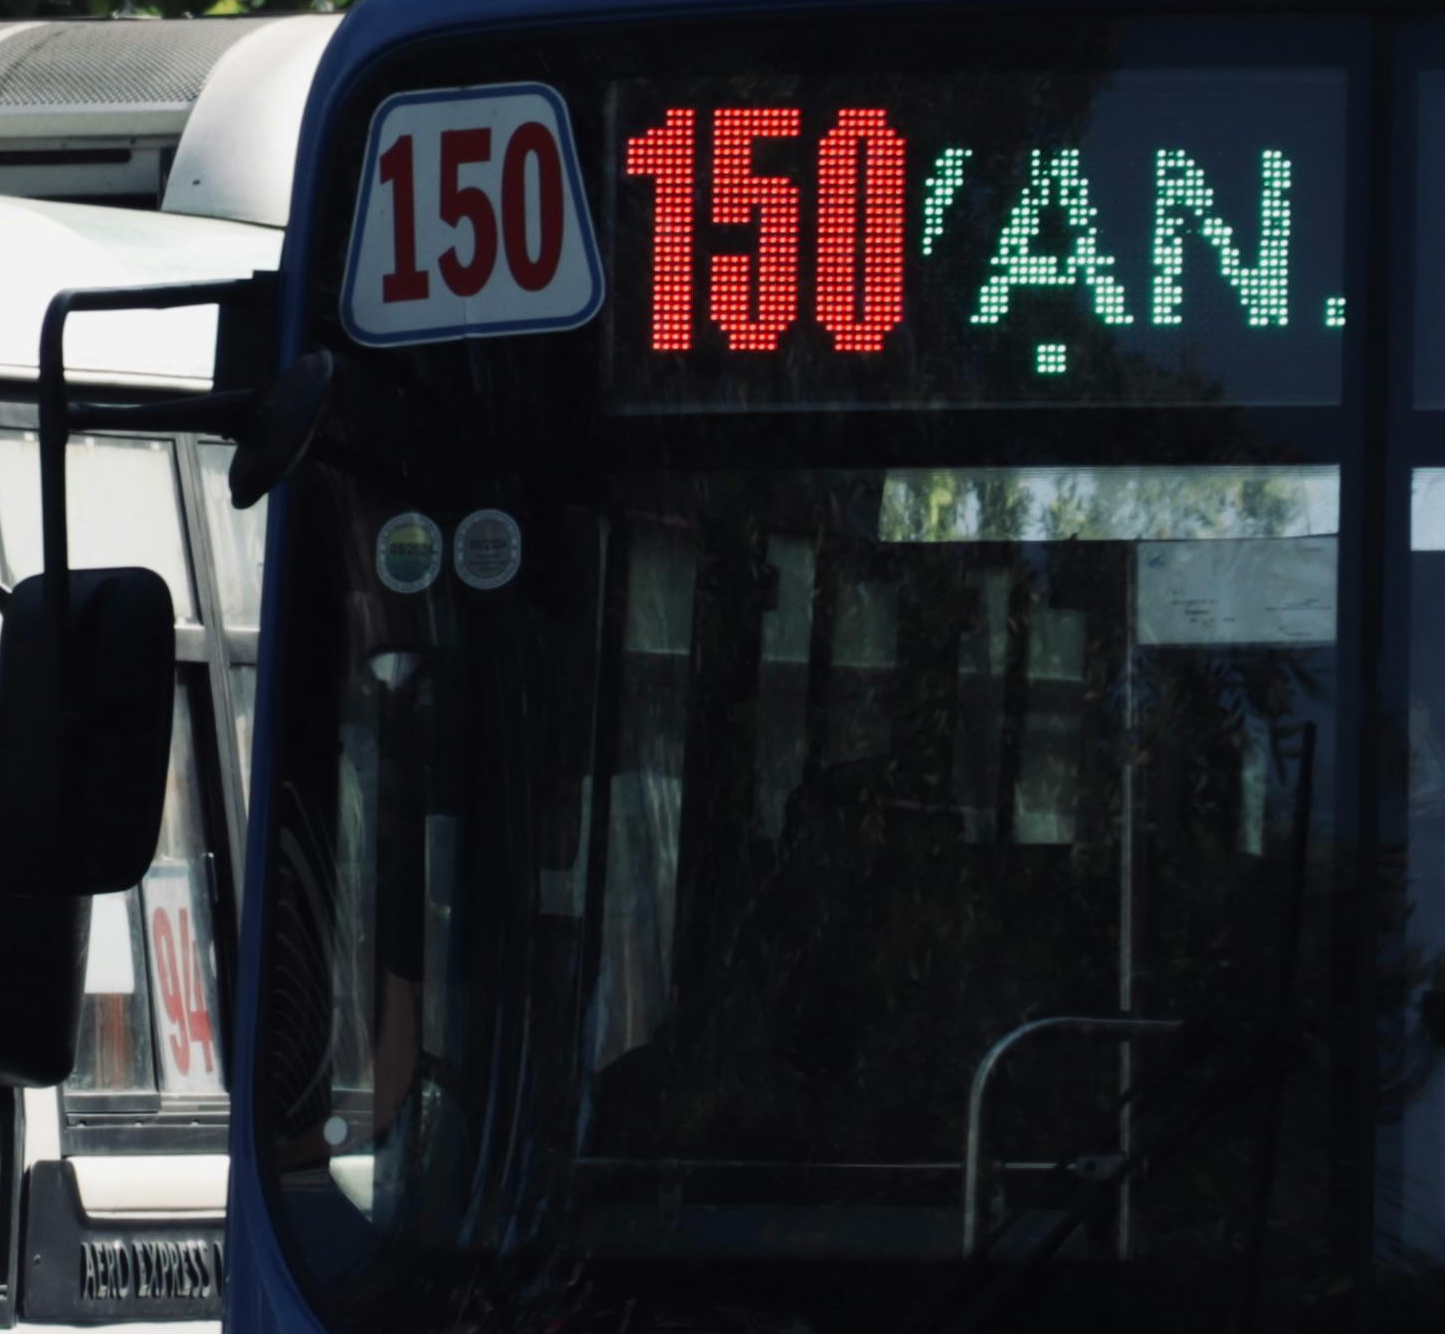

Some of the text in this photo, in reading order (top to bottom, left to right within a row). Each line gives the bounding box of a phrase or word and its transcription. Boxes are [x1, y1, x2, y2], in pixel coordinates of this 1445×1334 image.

[377, 121, 565, 304] 150
[626, 108, 906, 352] 150
[152, 906, 214, 1077] 94
[80, 1240, 130, 1300] AERO
[131, 1240, 210, 1300] EXPRESS
